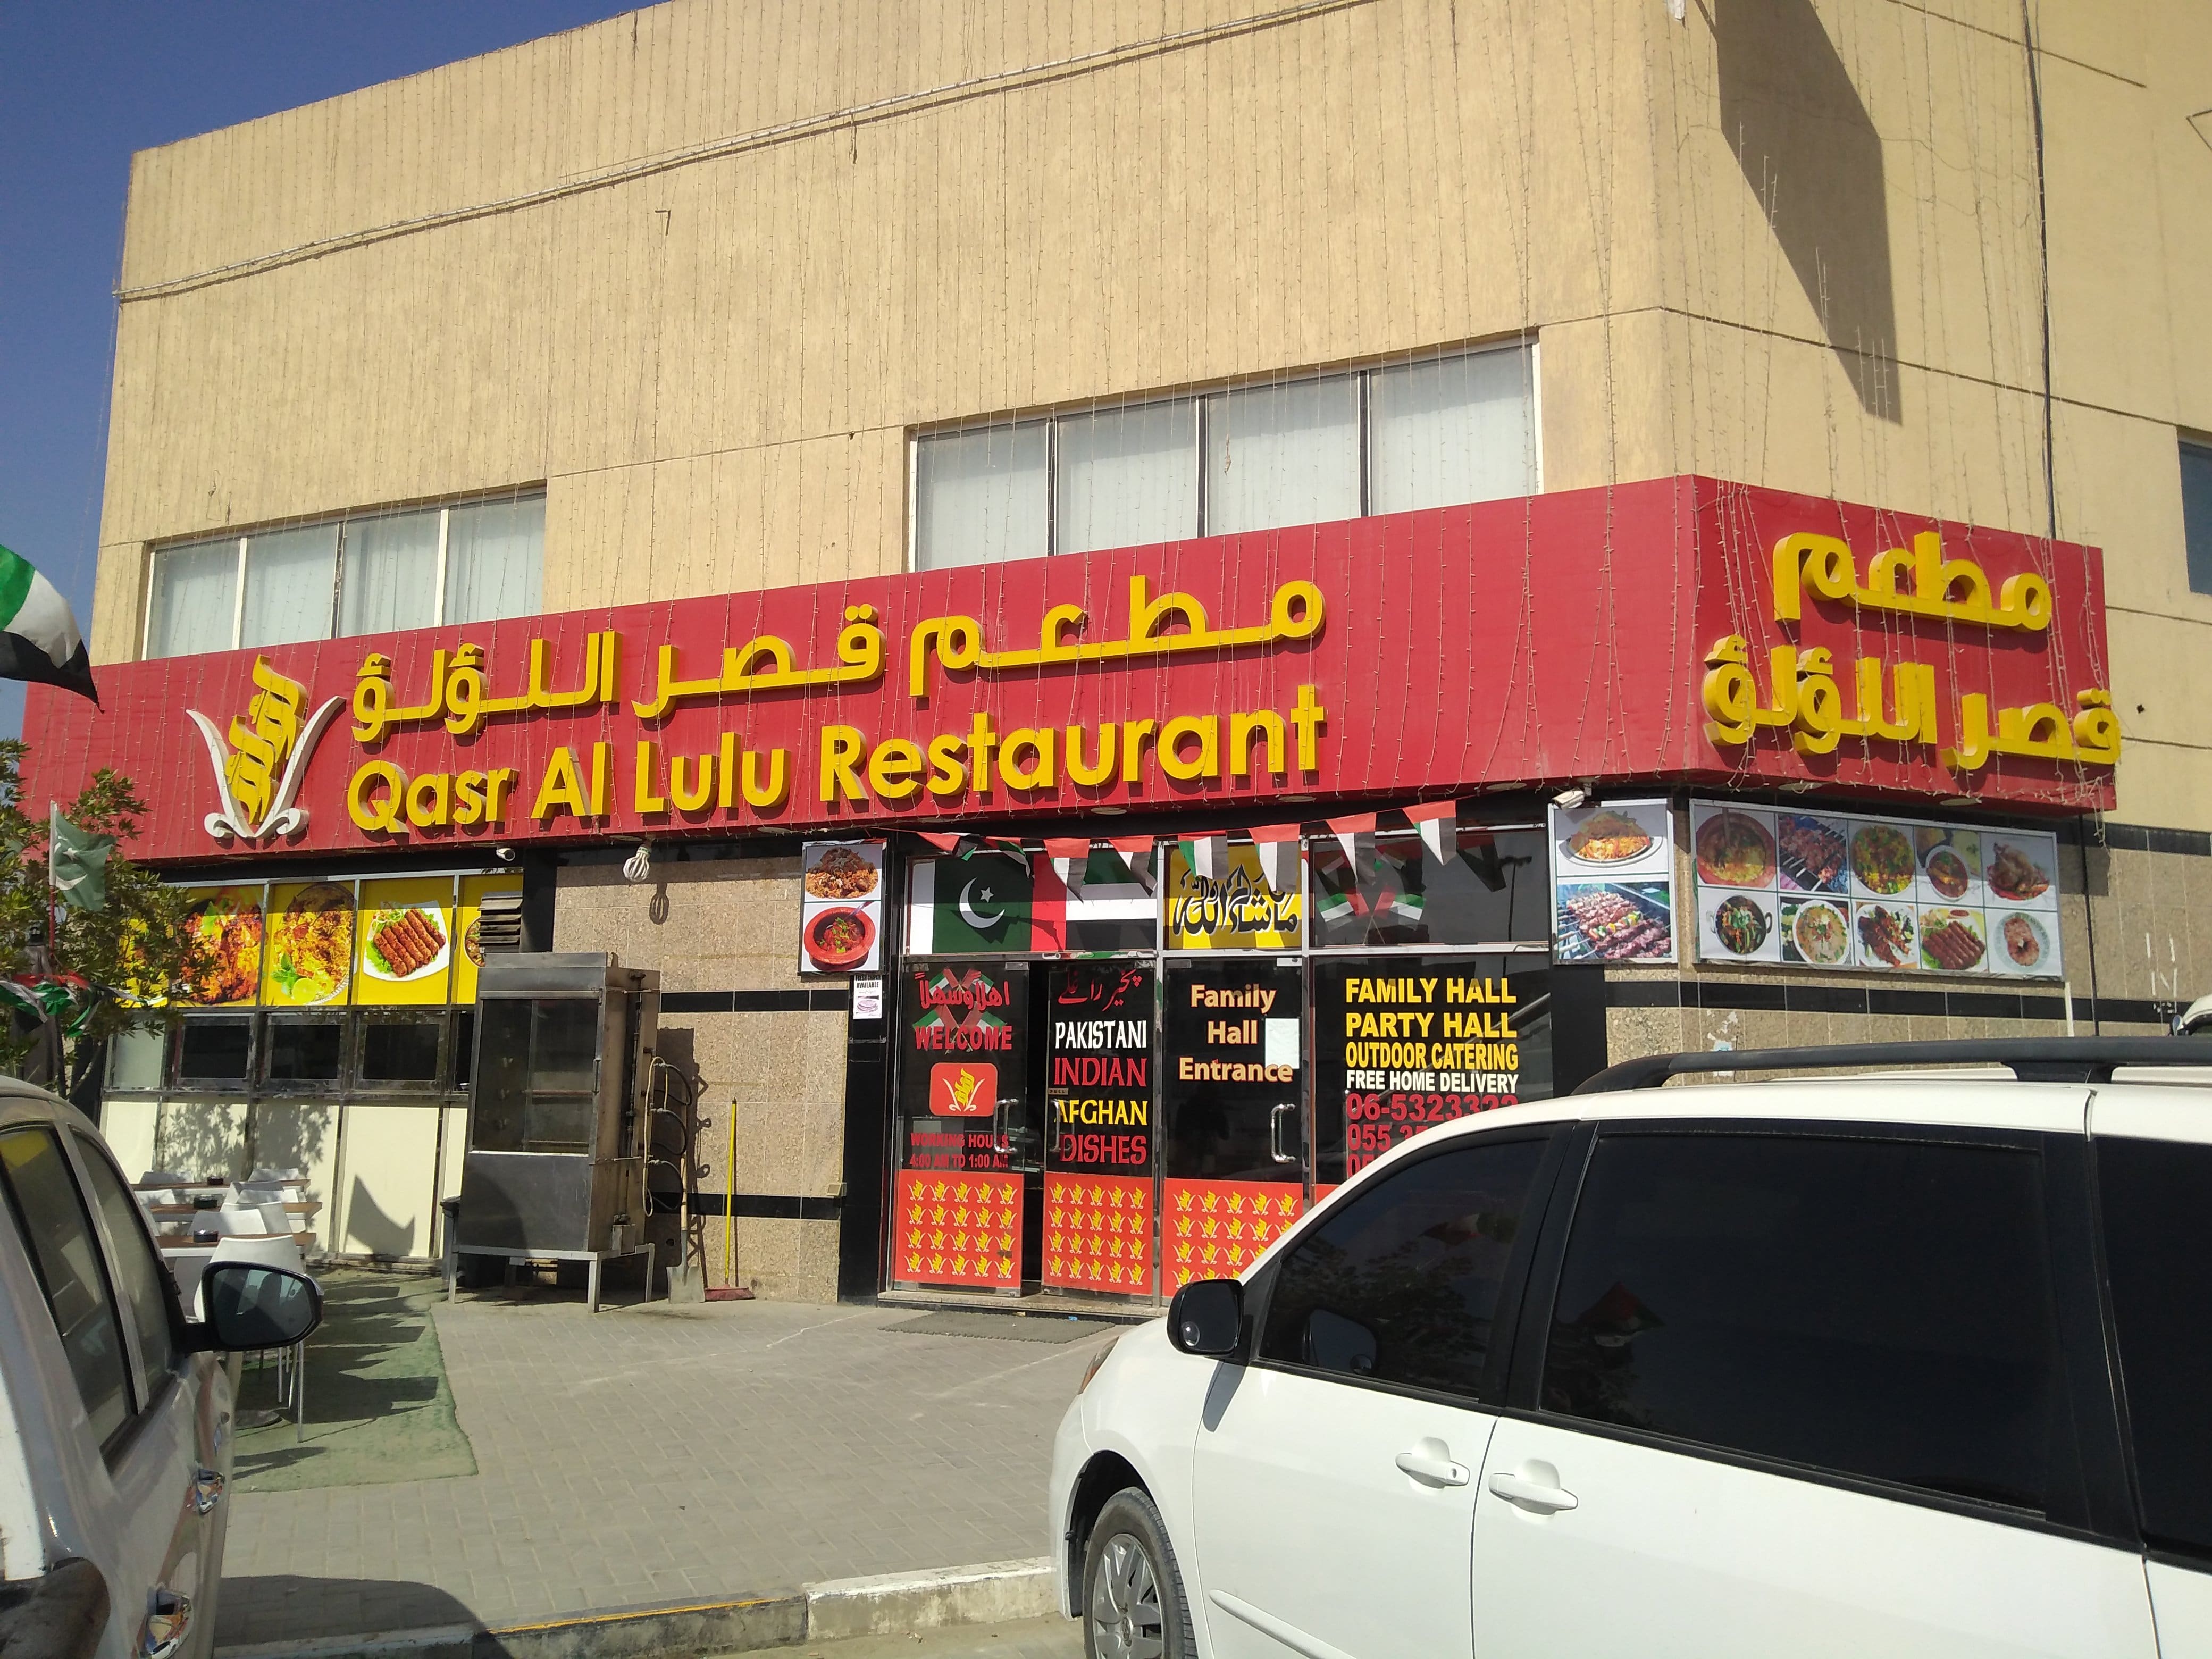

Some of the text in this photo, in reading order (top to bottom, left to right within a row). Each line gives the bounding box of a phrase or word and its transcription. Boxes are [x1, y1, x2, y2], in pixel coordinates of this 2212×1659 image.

[1773, 531, 2052, 633] مطعم
[910, 575, 1326, 697] مطعم
[631, 604, 886, 718] قصر
[351, 631, 623, 743] اللؤلؤ
[1704, 634, 2121, 770] قصر اللؤلؤ
[347, 684, 1326, 833] Qasr Al Lulu Restaurant
[1191, 984, 1277, 1014] Family
[1346, 978, 1517, 1004] FAMILY HALL
[915, 1026, 1012, 1050] WELCOME
[1055, 1020, 1147, 1049] PAKISTANI
[1208, 1020, 1258, 1044] Hall
[1346, 1012, 1518, 1038] PARTY HALL
[1179, 1057, 1293, 1083] Entrance
[1346, 1041, 1519, 1071] OUTDOOR CATERING
[1054, 1058, 1147, 1086] INDIAN
[1347, 1070, 1519, 1094] FREE HOME DELIVERY
[1054, 1099, 1148, 1125] AFGHAN
[910, 1133, 965, 1147] WORKING
[1059, 1134, 1147, 1164] DISHES
[910, 1154, 1008, 1168] 4:00 AM TO 1:00 AM
